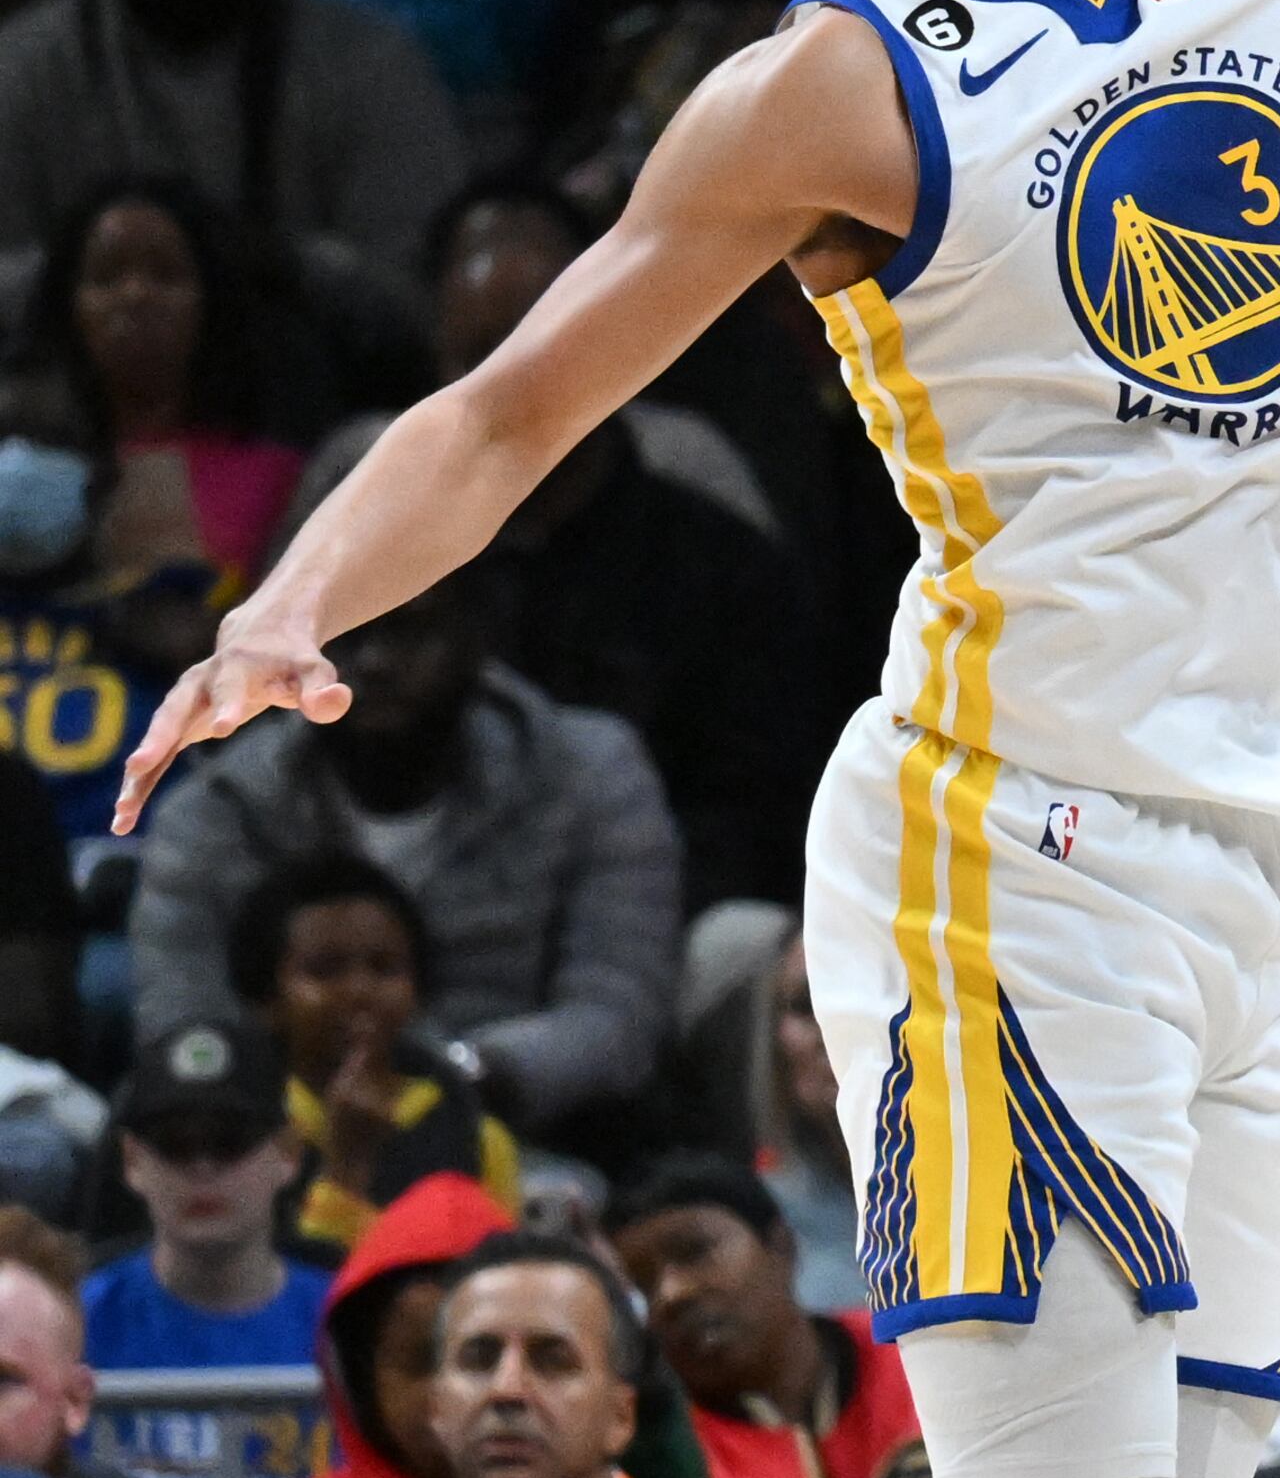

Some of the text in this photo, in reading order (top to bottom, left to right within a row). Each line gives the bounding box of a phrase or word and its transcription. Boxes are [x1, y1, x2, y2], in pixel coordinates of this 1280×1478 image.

[916, 7, 962, 47] 6
[1026, 61, 1150, 209] GOLDEN
[1218, 138, 1280, 226] 3
[0, 663, 127, 776] 0
